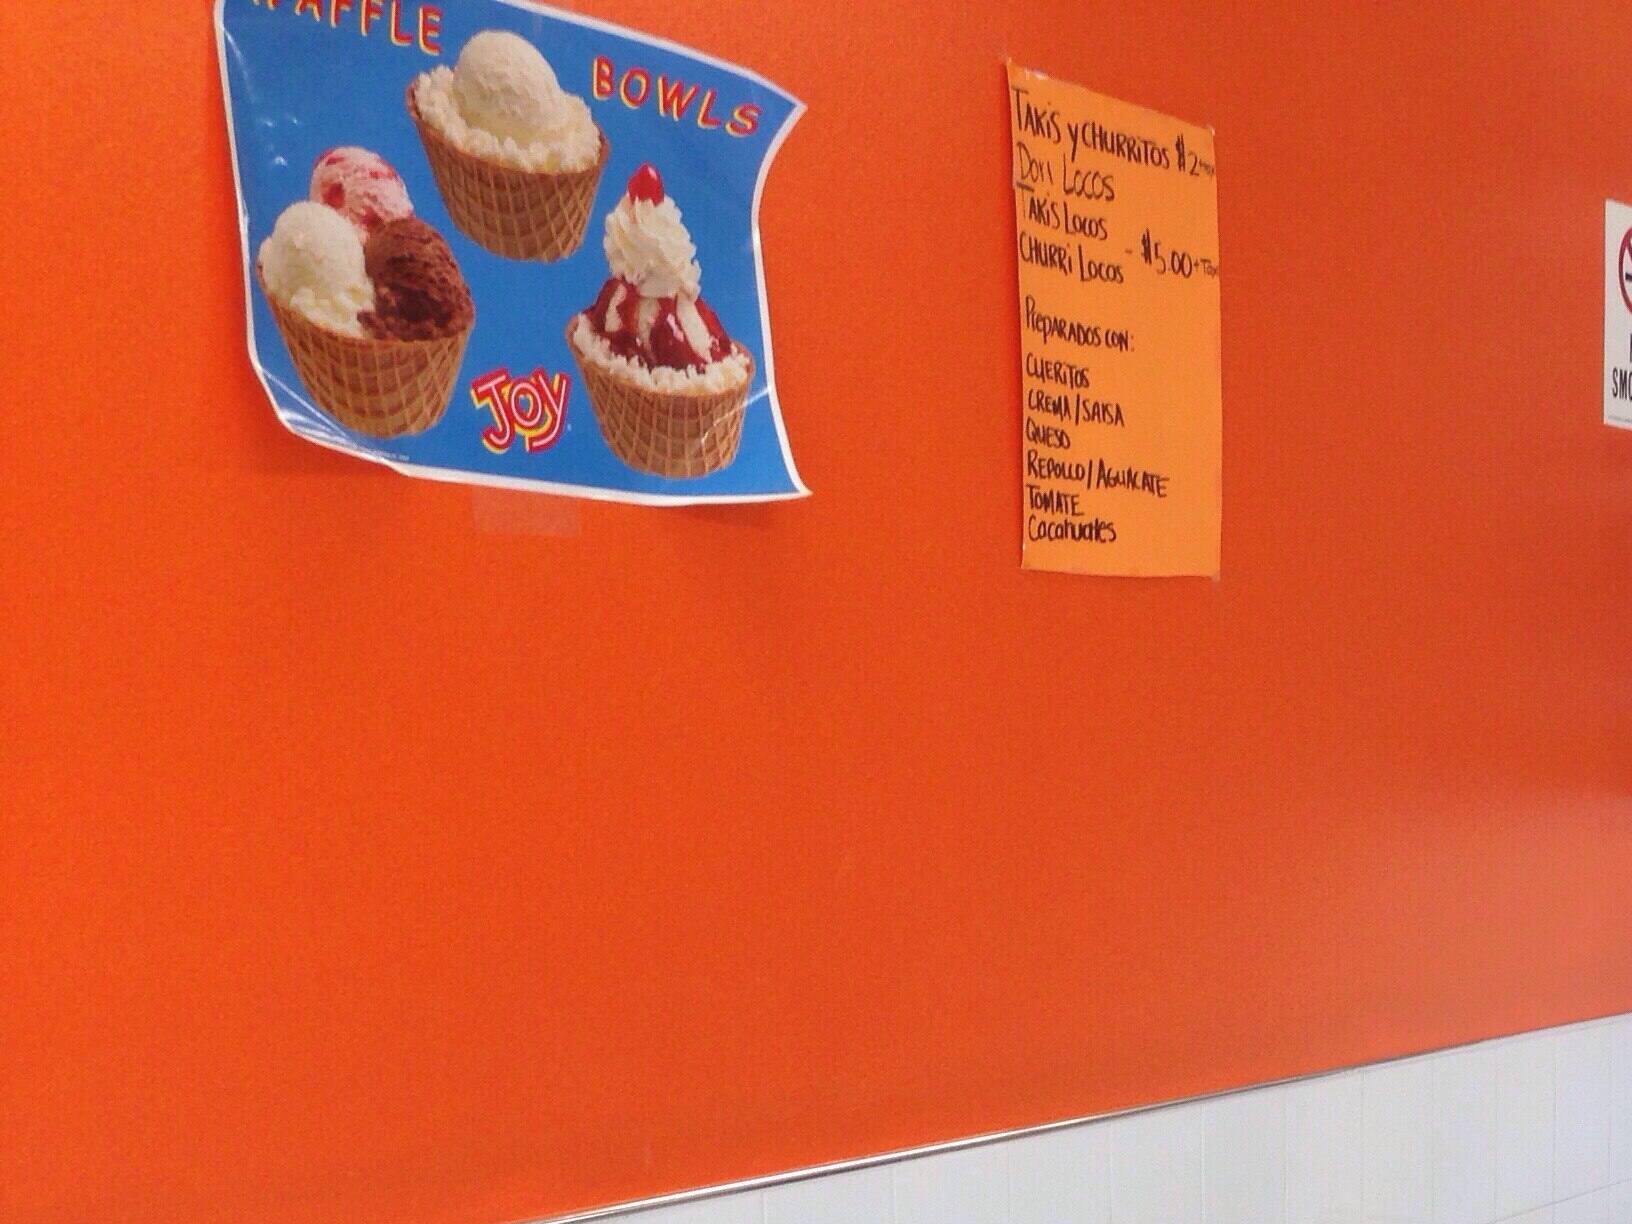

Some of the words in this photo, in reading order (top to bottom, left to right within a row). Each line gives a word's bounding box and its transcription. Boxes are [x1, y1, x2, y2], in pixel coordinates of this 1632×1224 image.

[592, 54, 763, 138] BOWLS
[470, 364, 572, 454] JOY
[1025, 416, 1071, 450] QUESO
[1026, 483, 1085, 517] TOMATE
